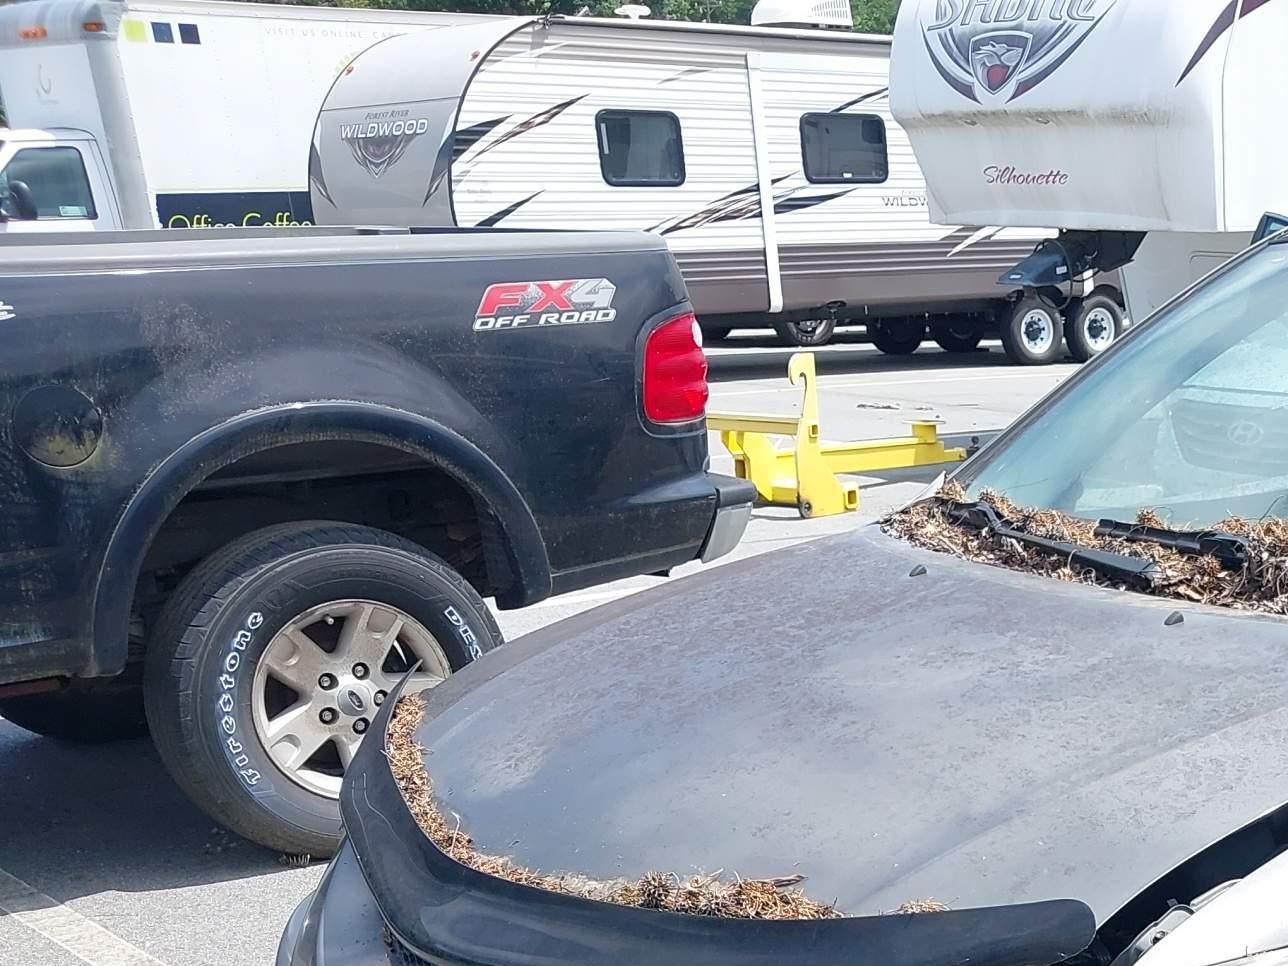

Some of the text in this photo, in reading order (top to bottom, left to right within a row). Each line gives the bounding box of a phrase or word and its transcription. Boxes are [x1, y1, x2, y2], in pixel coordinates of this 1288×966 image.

[340, 118, 428, 140] WILDWOOD
[983, 165, 1069, 186] Silhouette
[479, 277, 617, 316] FX4
[474, 309, 617, 330] OFF ROAD
[218, 610, 265, 786] Firestone
